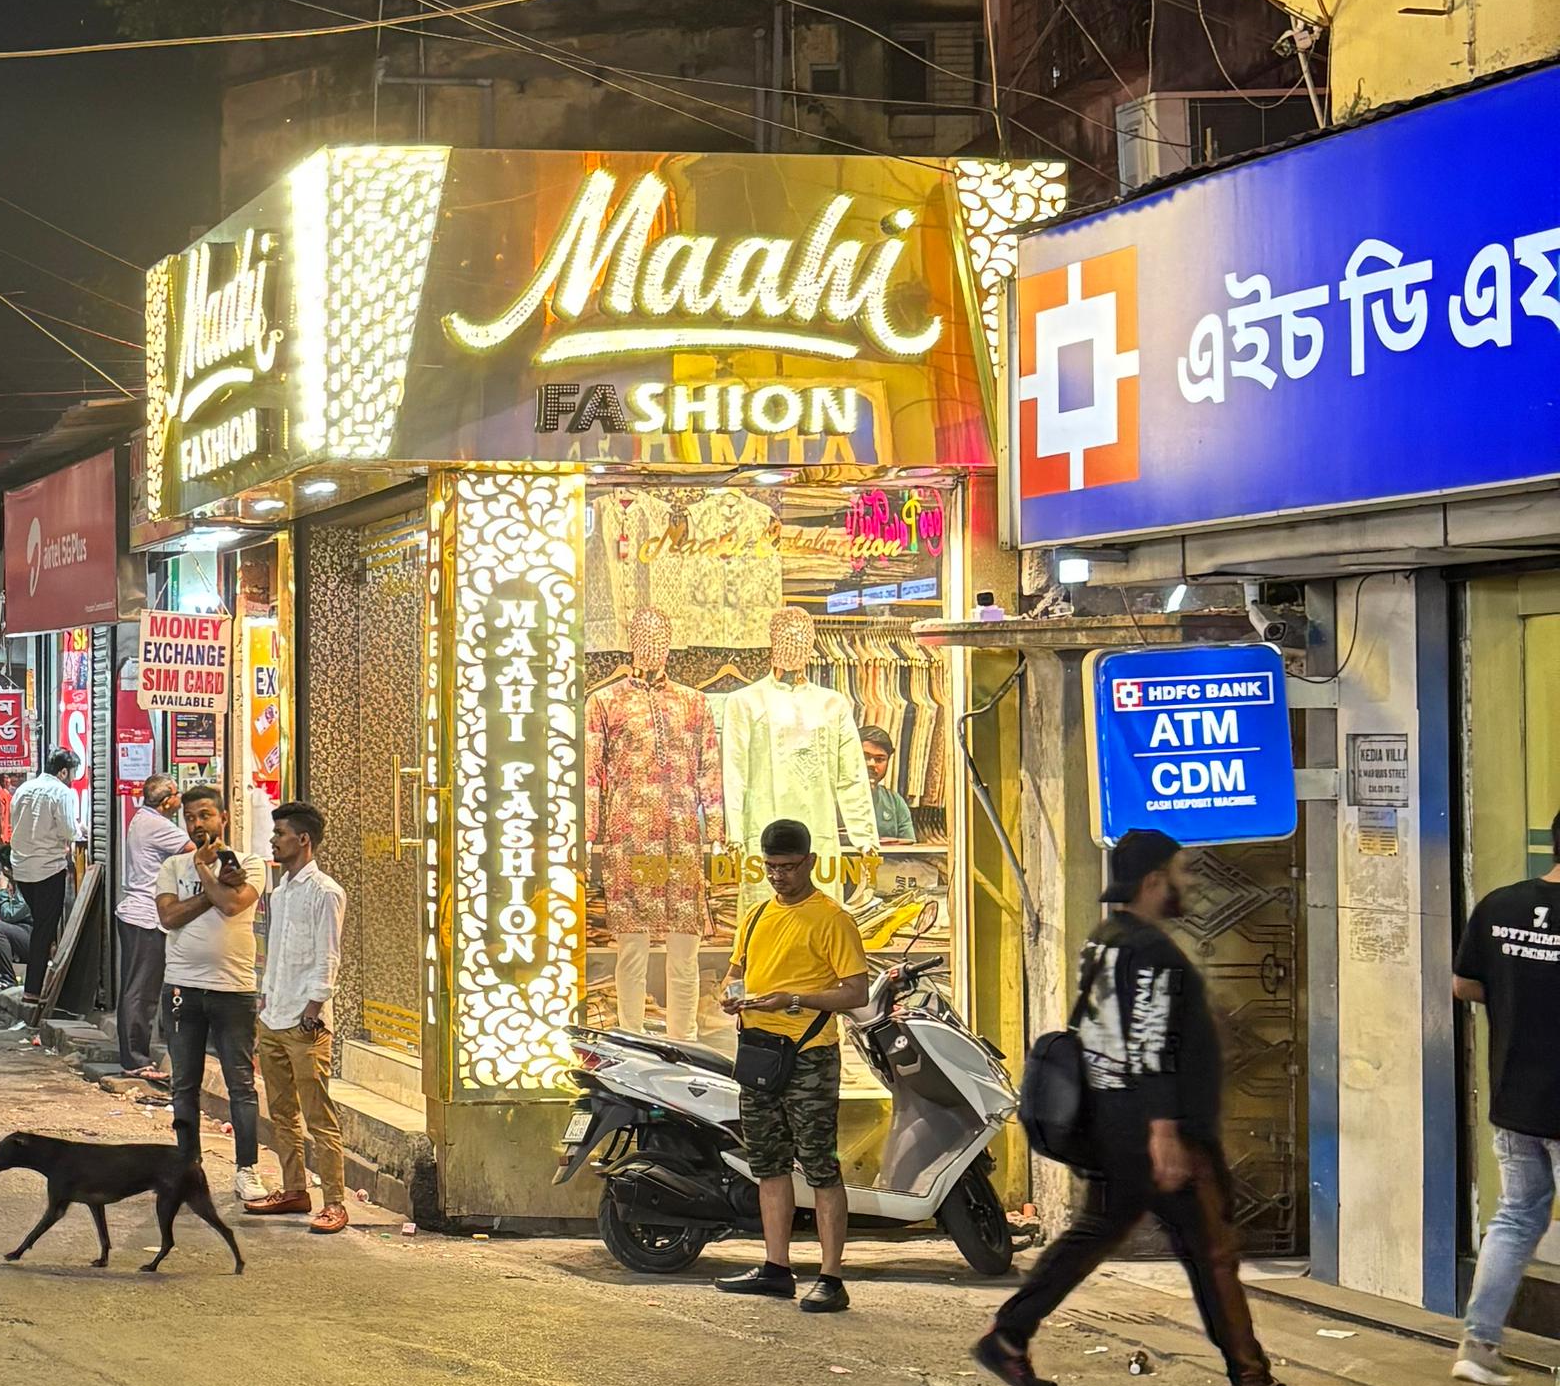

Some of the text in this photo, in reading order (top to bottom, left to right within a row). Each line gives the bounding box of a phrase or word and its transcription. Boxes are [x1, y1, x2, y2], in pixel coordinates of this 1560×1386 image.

[440, 167, 944, 359] Maahi
[1177, 271, 1330, 404] এইচ
[1339, 238, 1433, 377] ডি
[534, 381, 858, 434] FASHION
[180, 407, 258, 483] FASHION
[42, 536, 61, 570] airtel
[149, 615, 223, 641] MONEY
[143, 641, 226, 667] EXCHANGE
[142, 667, 225, 695] SIM CARD
[1147, 681, 1263, 702] HDFC BANK
[151, 694, 215, 708] AVAILABLE
[1149, 709, 1239, 748] ATM
[1360, 749, 1407, 762] KEDIA VILLA
[494, 599, 539, 965] MAAHI FASHION
[1151, 759, 1246, 796] CDM
[1146, 795, 1257, 812] CASH DEPOSIT MACHINE
[710, 854, 884, 885] DISUNT
